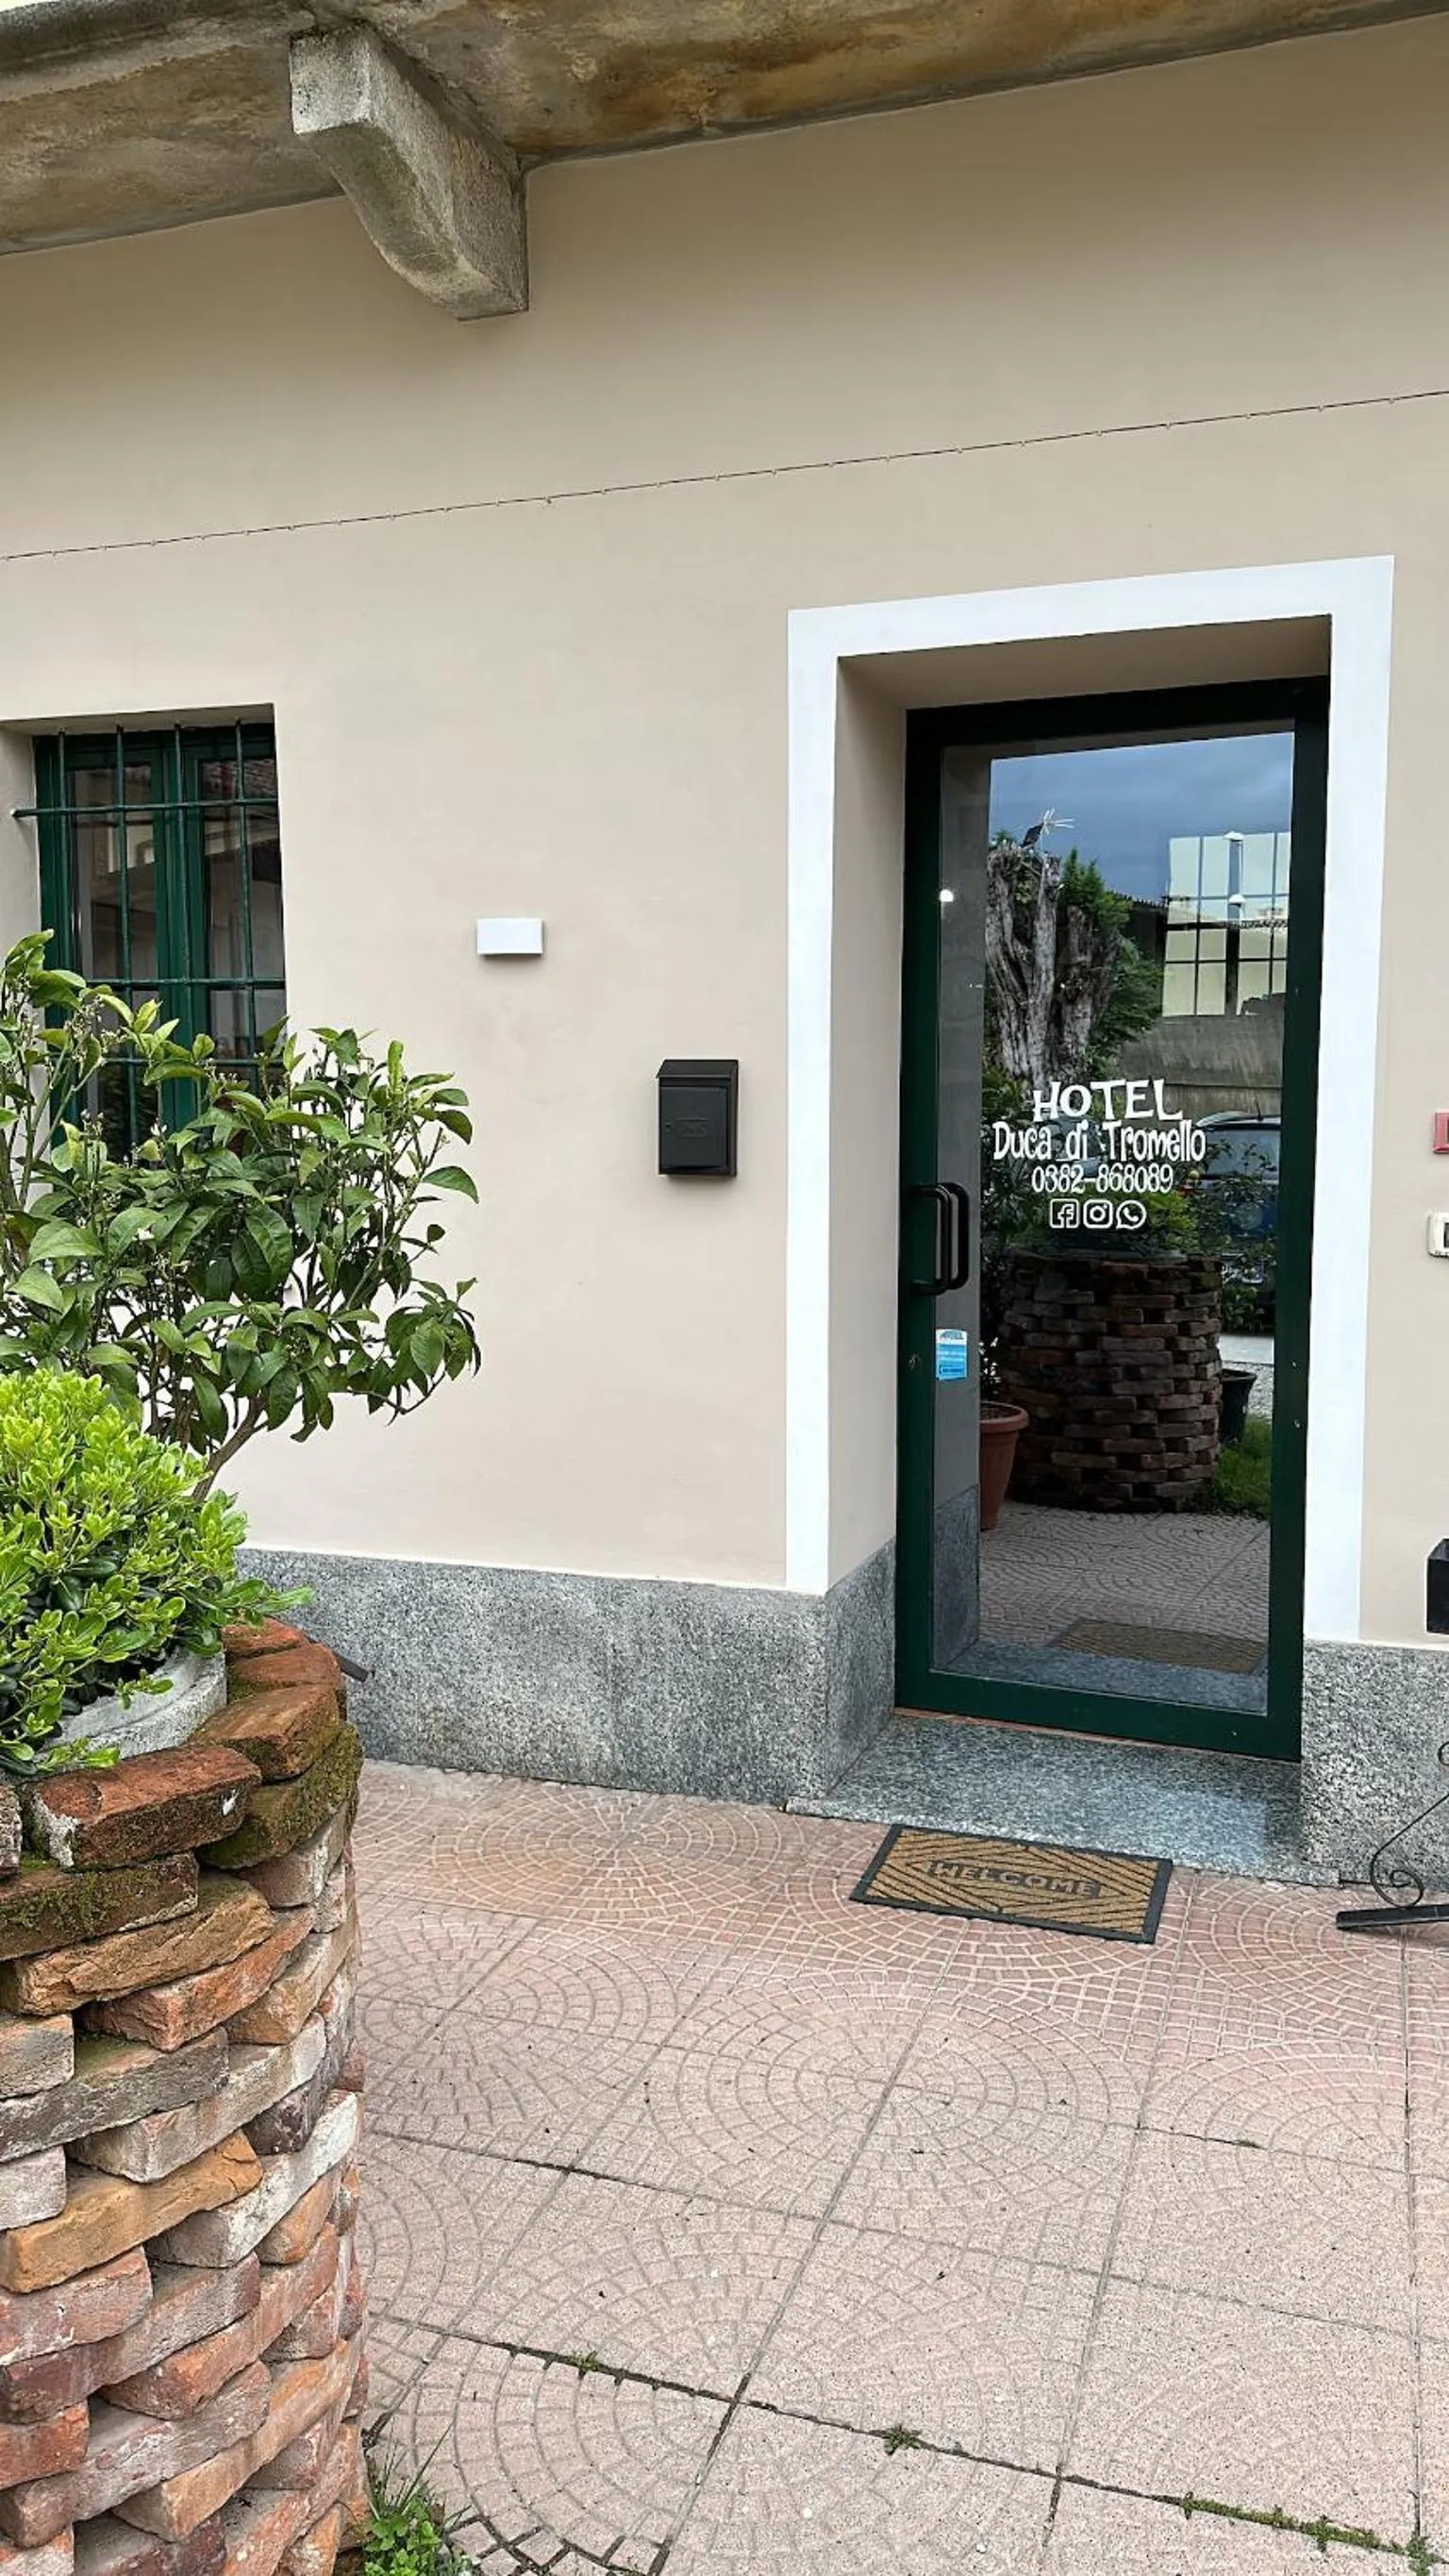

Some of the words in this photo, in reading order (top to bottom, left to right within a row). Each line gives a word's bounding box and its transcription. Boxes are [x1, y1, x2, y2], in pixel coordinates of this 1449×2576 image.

[1033, 1079, 1183, 1122] HOTEL
[992, 1121, 1052, 1160] Duca
[1066, 1119, 1088, 1161] di
[1103, 1119, 1206, 1162] Tromello
[1032, 1164, 1174, 1194] 0382-868089
[933, 1862, 1094, 1897] WELCOME
